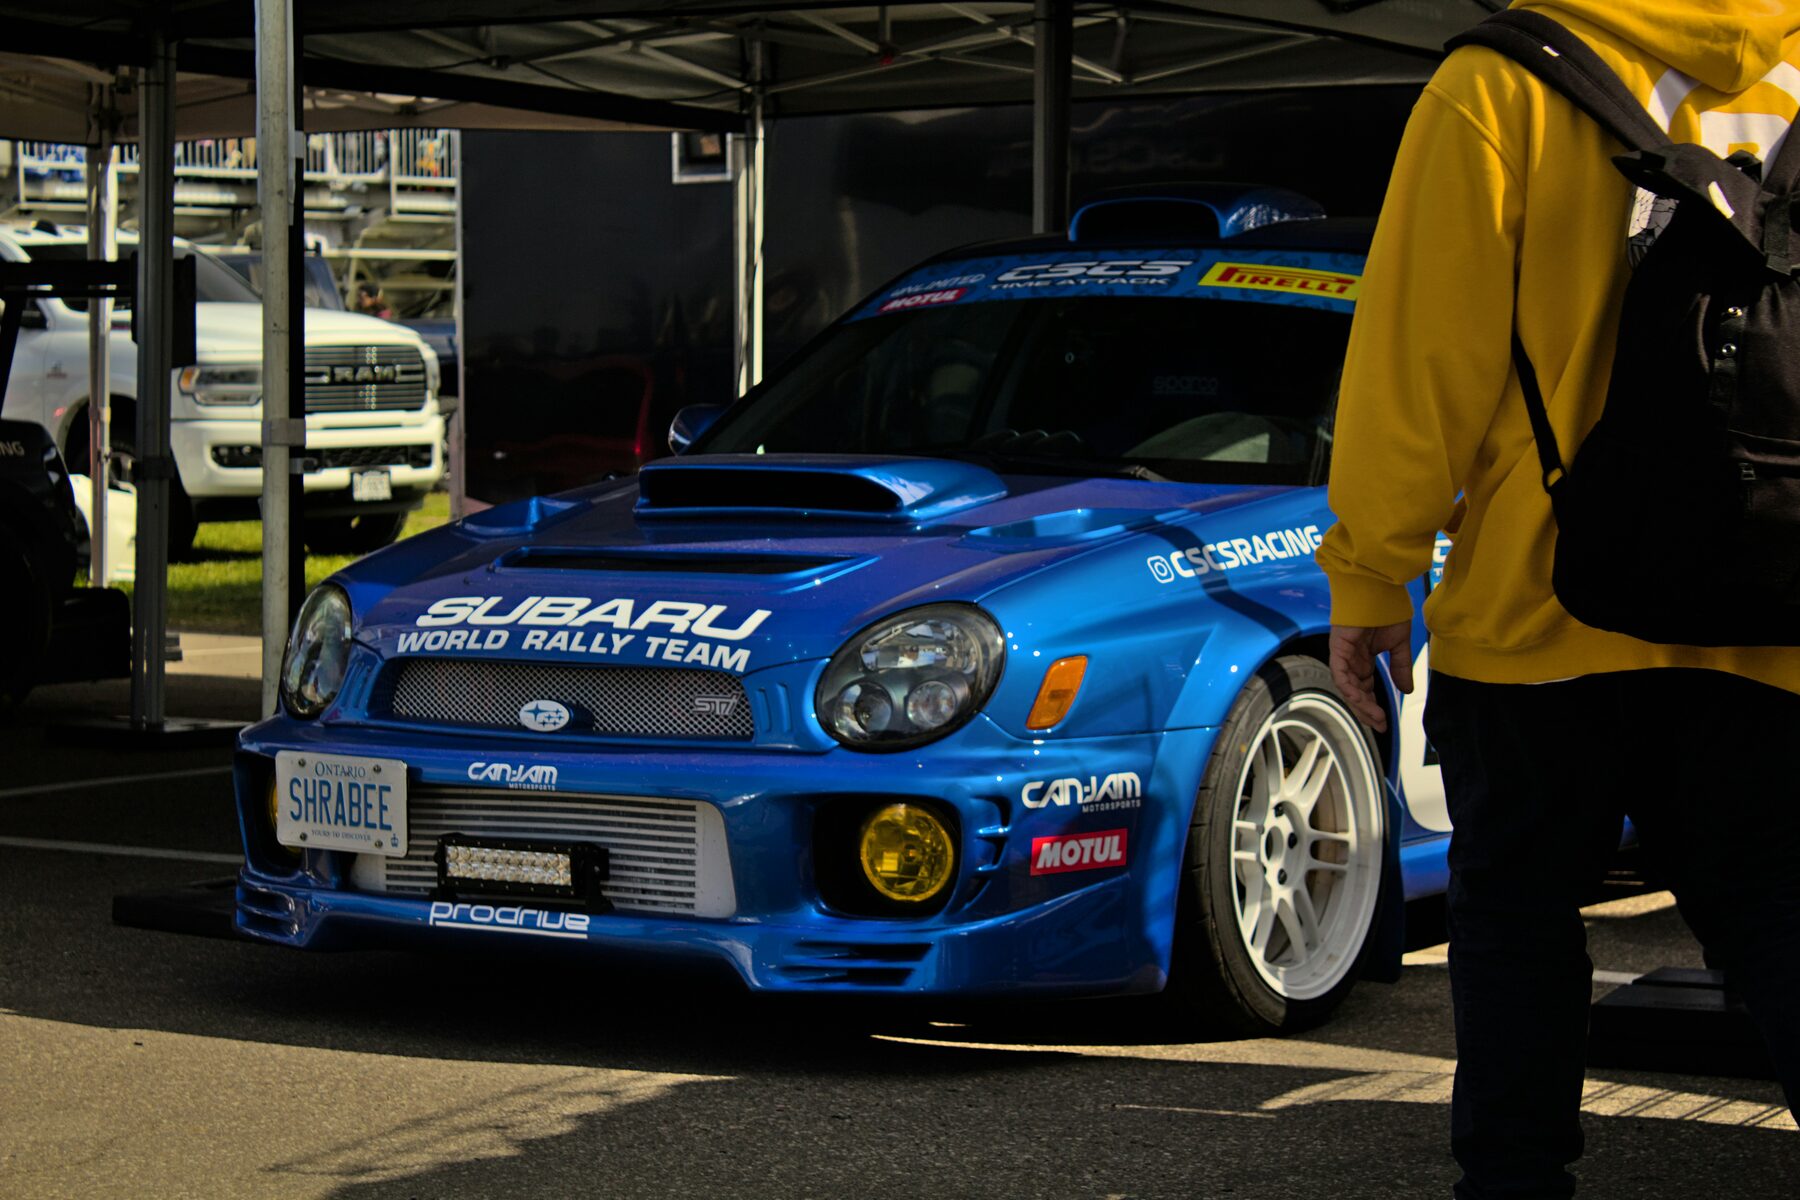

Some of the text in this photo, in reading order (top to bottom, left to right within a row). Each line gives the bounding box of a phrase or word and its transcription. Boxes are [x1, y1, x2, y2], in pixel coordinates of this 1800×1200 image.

[997, 260, 1193, 281] CSCS
[1216, 266, 1356, 294] PIRELLI
[990, 277, 1170, 290] TIME ATTACK
[881, 288, 961, 311] MOTUL
[334, 366, 395, 382] RAM
[1170, 525, 1323, 578] CSCSRACING
[416, 596, 772, 640] SUBARU
[397, 630, 751, 673] WORLD RALLY TEAM
[693, 692, 740, 716] STI
[315, 761, 366, 779] ONTARIO
[509, 783, 556, 791] MOTORSPORTS
[290, 777, 393, 831] SHRABEE
[1082, 799, 1141, 813] MOTORSPORTS
[1036, 835, 1122, 869] MOTUL
